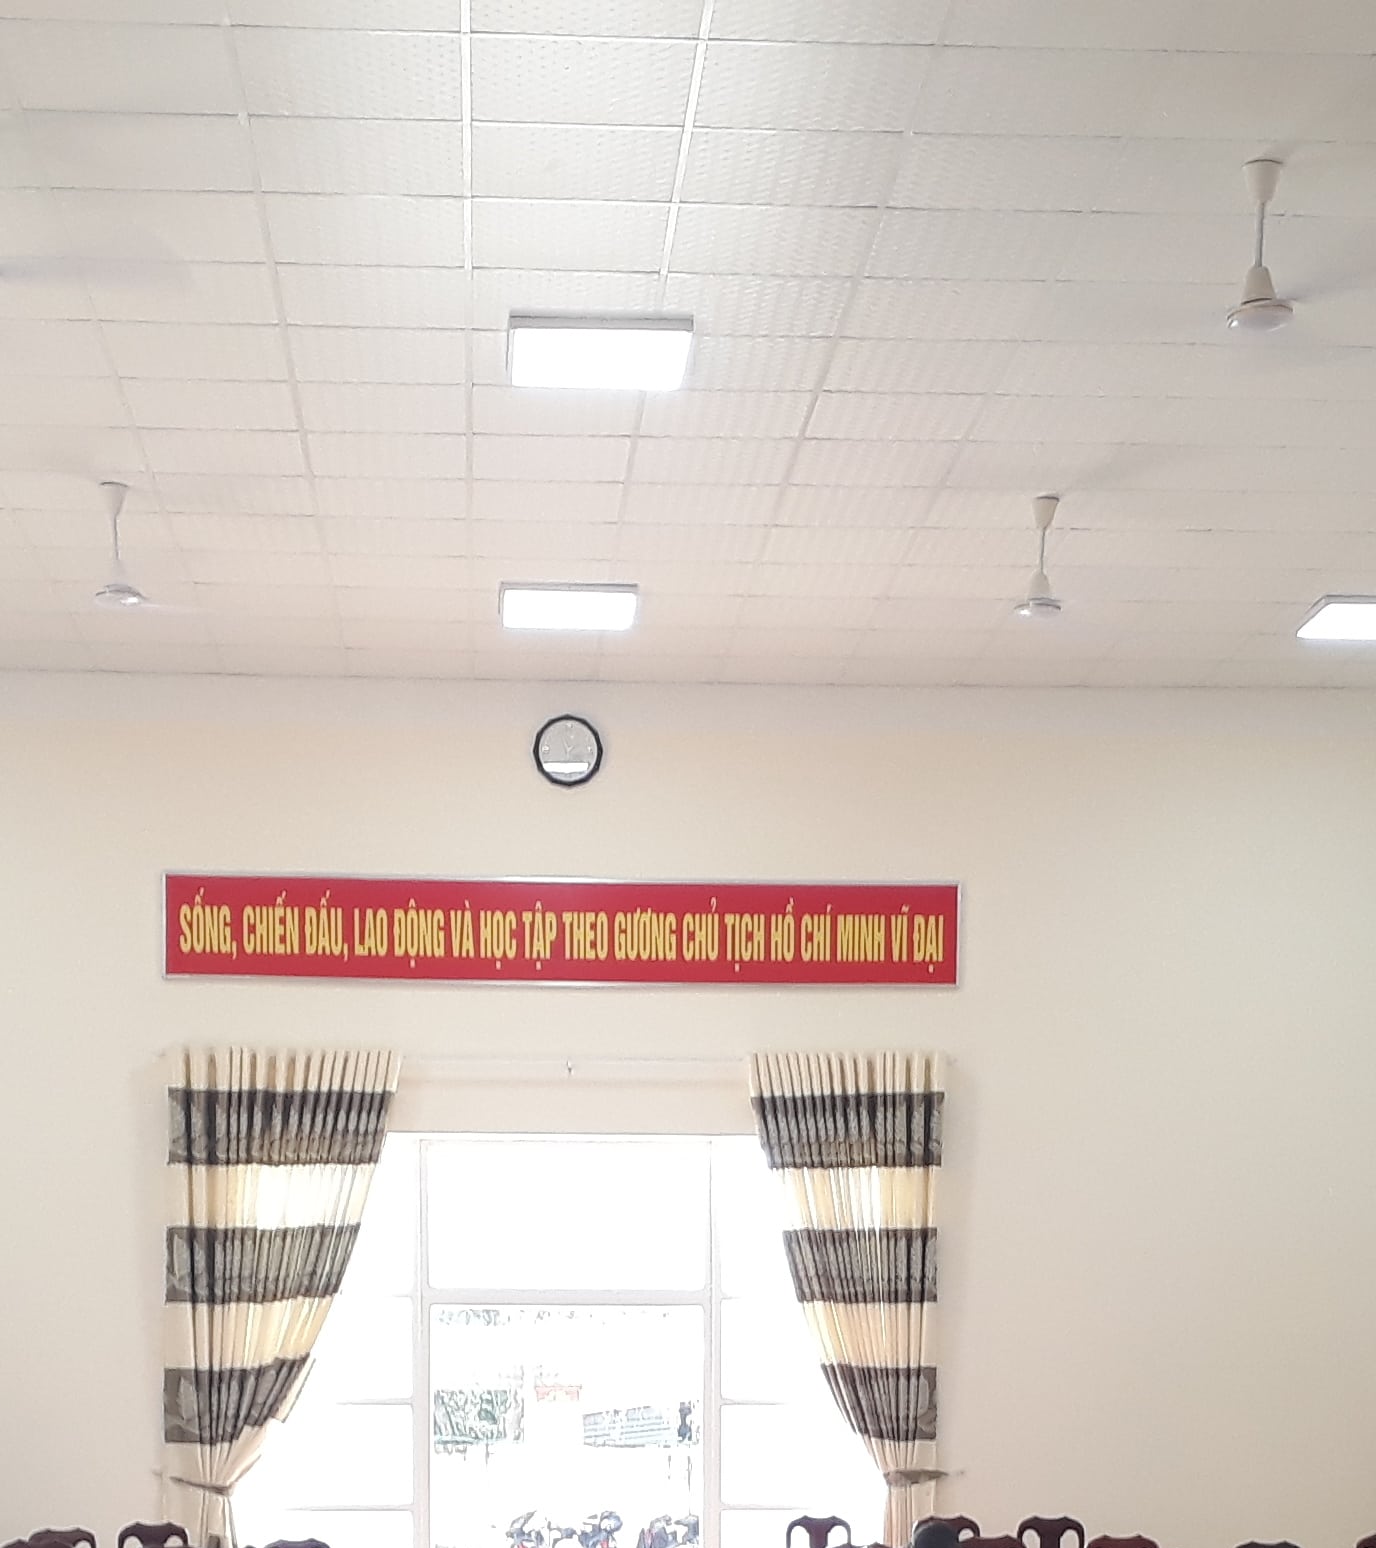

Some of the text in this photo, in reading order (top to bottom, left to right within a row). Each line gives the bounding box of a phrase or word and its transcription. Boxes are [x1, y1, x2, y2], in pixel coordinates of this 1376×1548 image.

[179, 887, 944, 973] SỐNG, CHIẾN ĐẤU, LAO ĐỘNG VÀ HỌC TẬP THEO GƯƠNG CHỦ TỊCH HỒ CHÍ MINH VĨ ĐẠI
